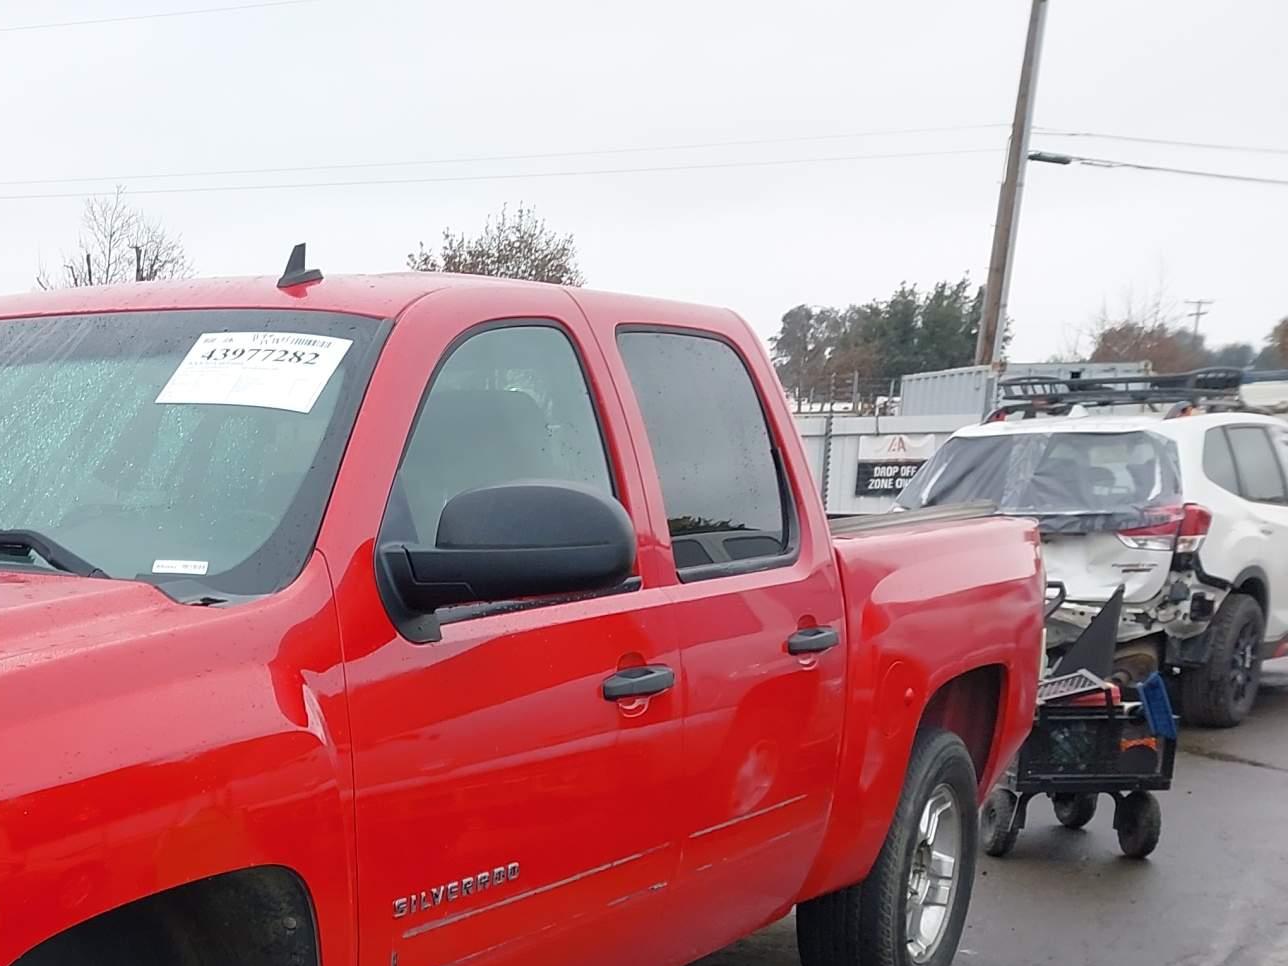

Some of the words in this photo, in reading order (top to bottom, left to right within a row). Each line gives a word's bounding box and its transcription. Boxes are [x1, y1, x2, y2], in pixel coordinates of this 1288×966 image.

[200, 348, 321, 365] 43977282
[873, 466, 900, 478] DROP
[900, 465, 918, 477] OFF
[868, 478, 895, 489] ZONE
[392, 861, 521, 918] SILVERADO
